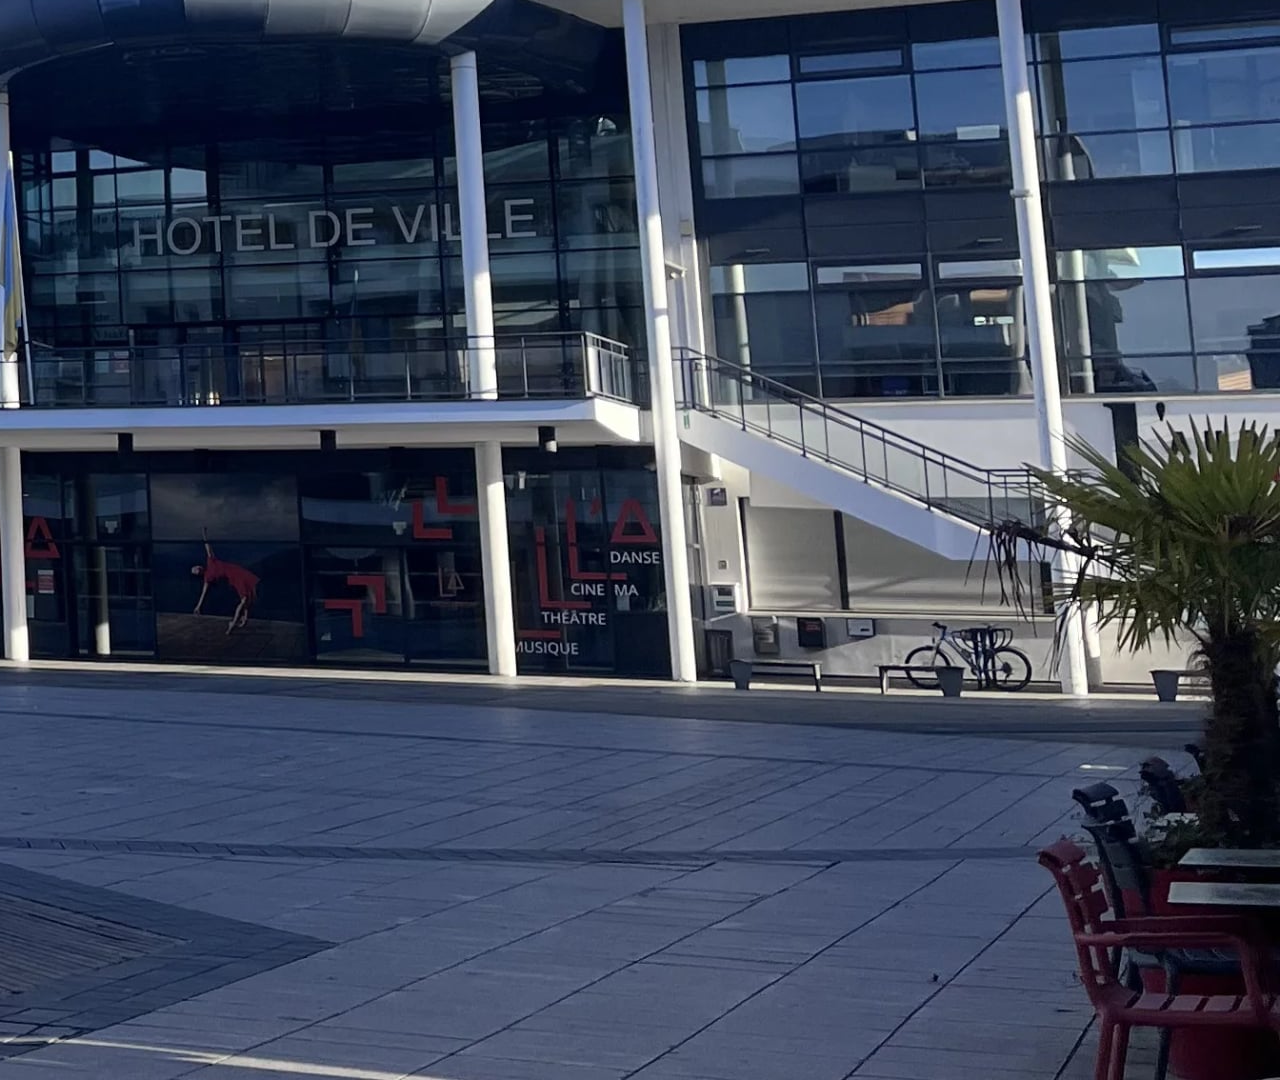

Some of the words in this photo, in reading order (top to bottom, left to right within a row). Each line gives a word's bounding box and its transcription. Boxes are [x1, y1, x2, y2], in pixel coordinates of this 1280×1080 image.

[133, 210, 295, 256] HOTEL
[308, 206, 377, 249] DE
[610, 551, 661, 565] DANSE
